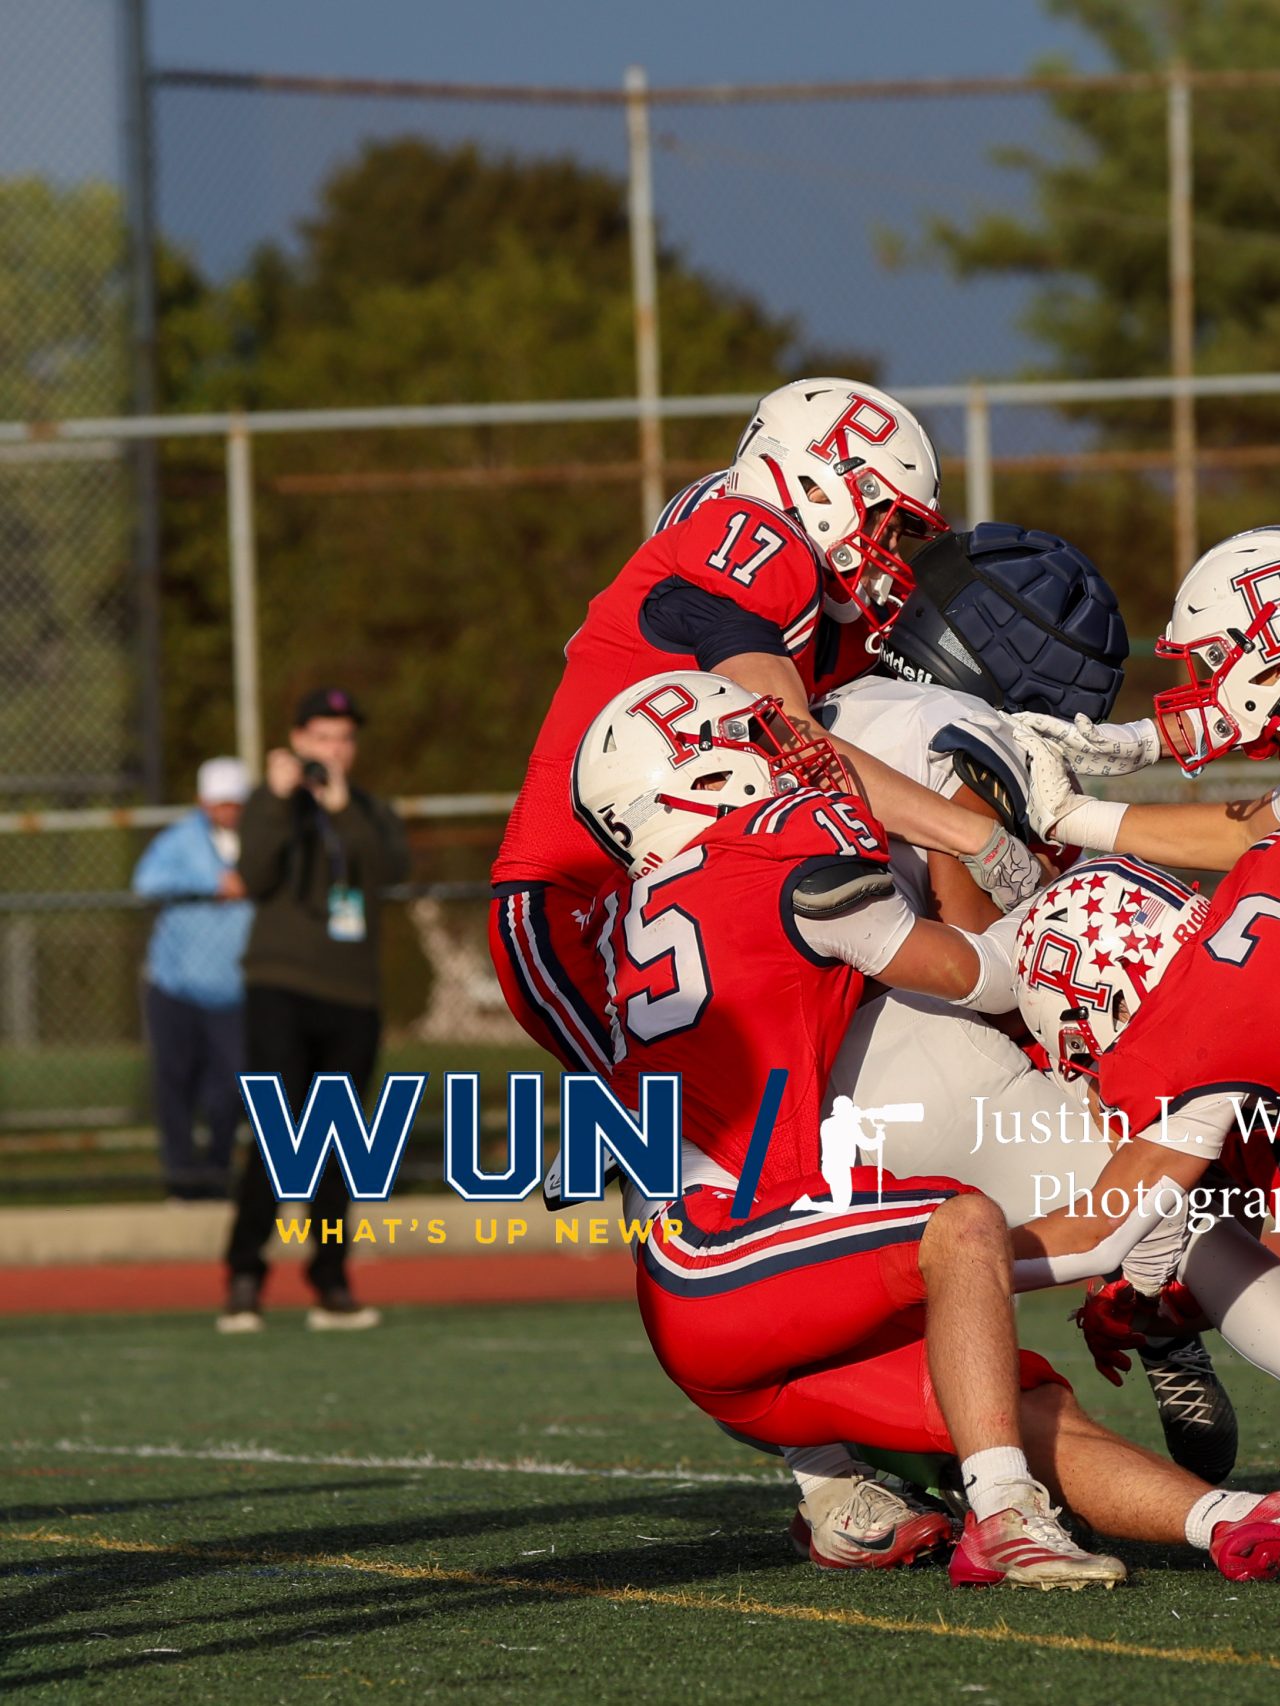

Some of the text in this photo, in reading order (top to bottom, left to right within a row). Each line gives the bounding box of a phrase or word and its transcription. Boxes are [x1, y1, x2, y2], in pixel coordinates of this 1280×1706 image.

[806, 392, 899, 465] P
[706, 511, 787, 588] 17
[625, 684, 700, 770] P
[813, 799, 880, 857] 15
[1029, 928, 1113, 1013] P
